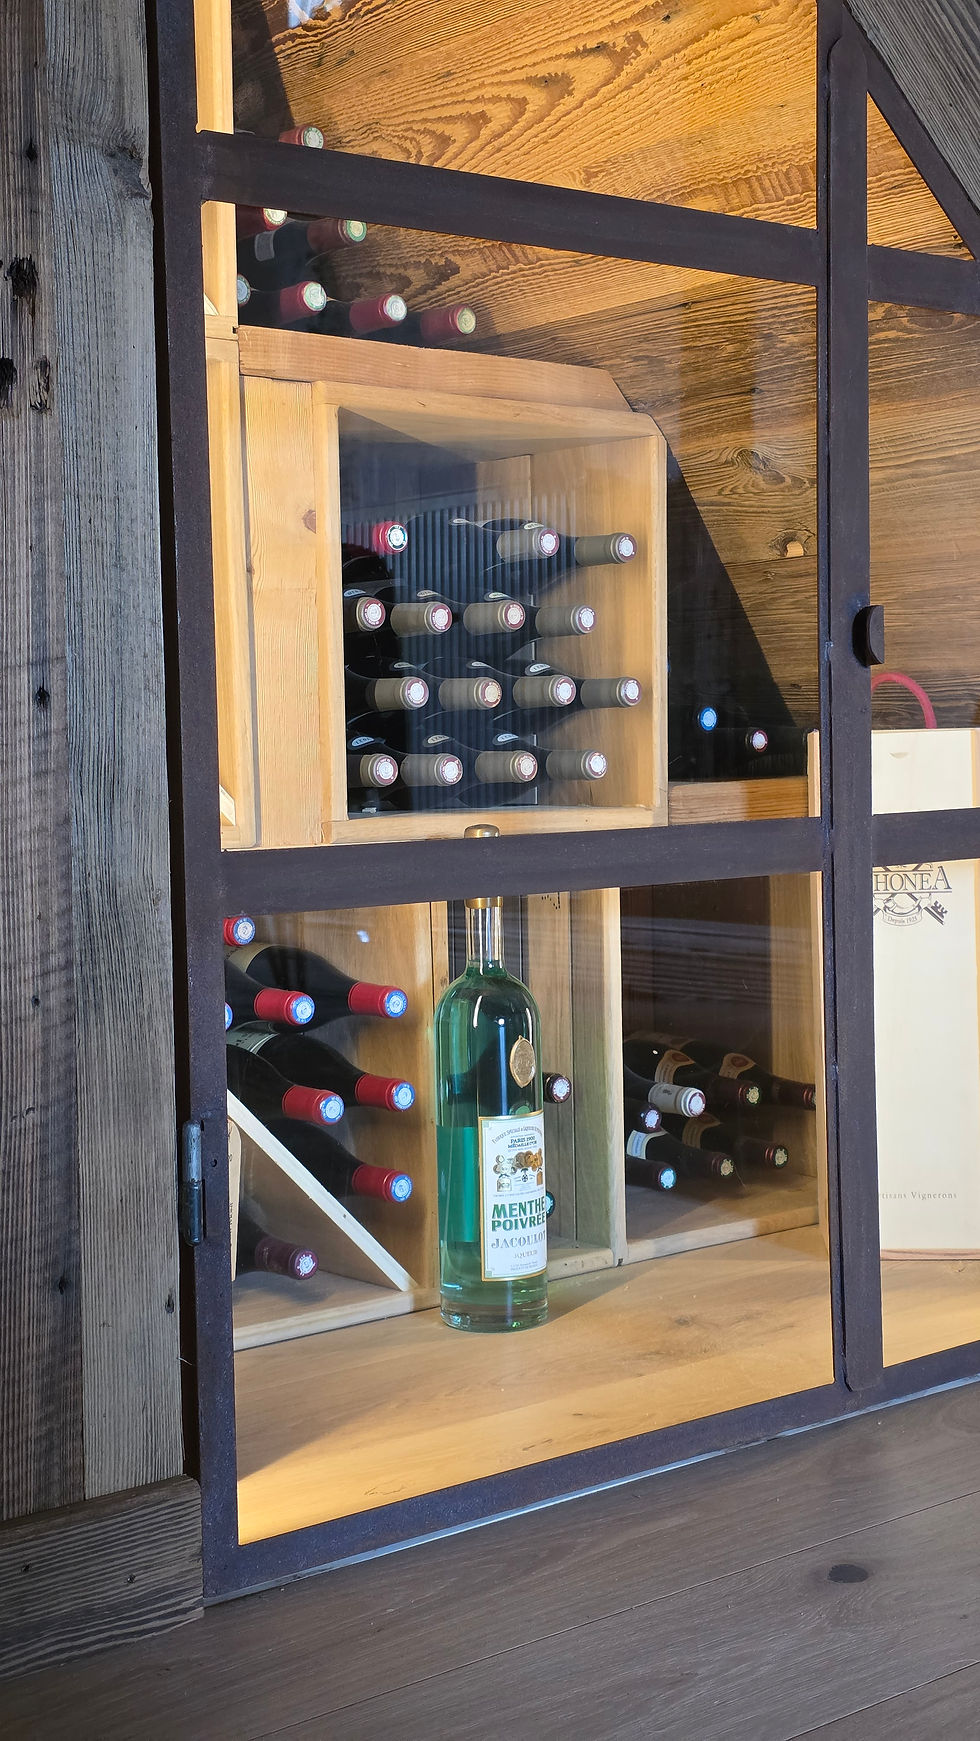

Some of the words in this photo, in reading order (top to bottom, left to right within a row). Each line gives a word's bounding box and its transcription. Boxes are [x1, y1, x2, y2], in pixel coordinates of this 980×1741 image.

[873, 866, 952, 891] HONEA
[879, 1192, 907, 1200] tisans
[910, 1191, 958, 1200] Vignerons
[491, 1196, 545, 1219] MENTHE
